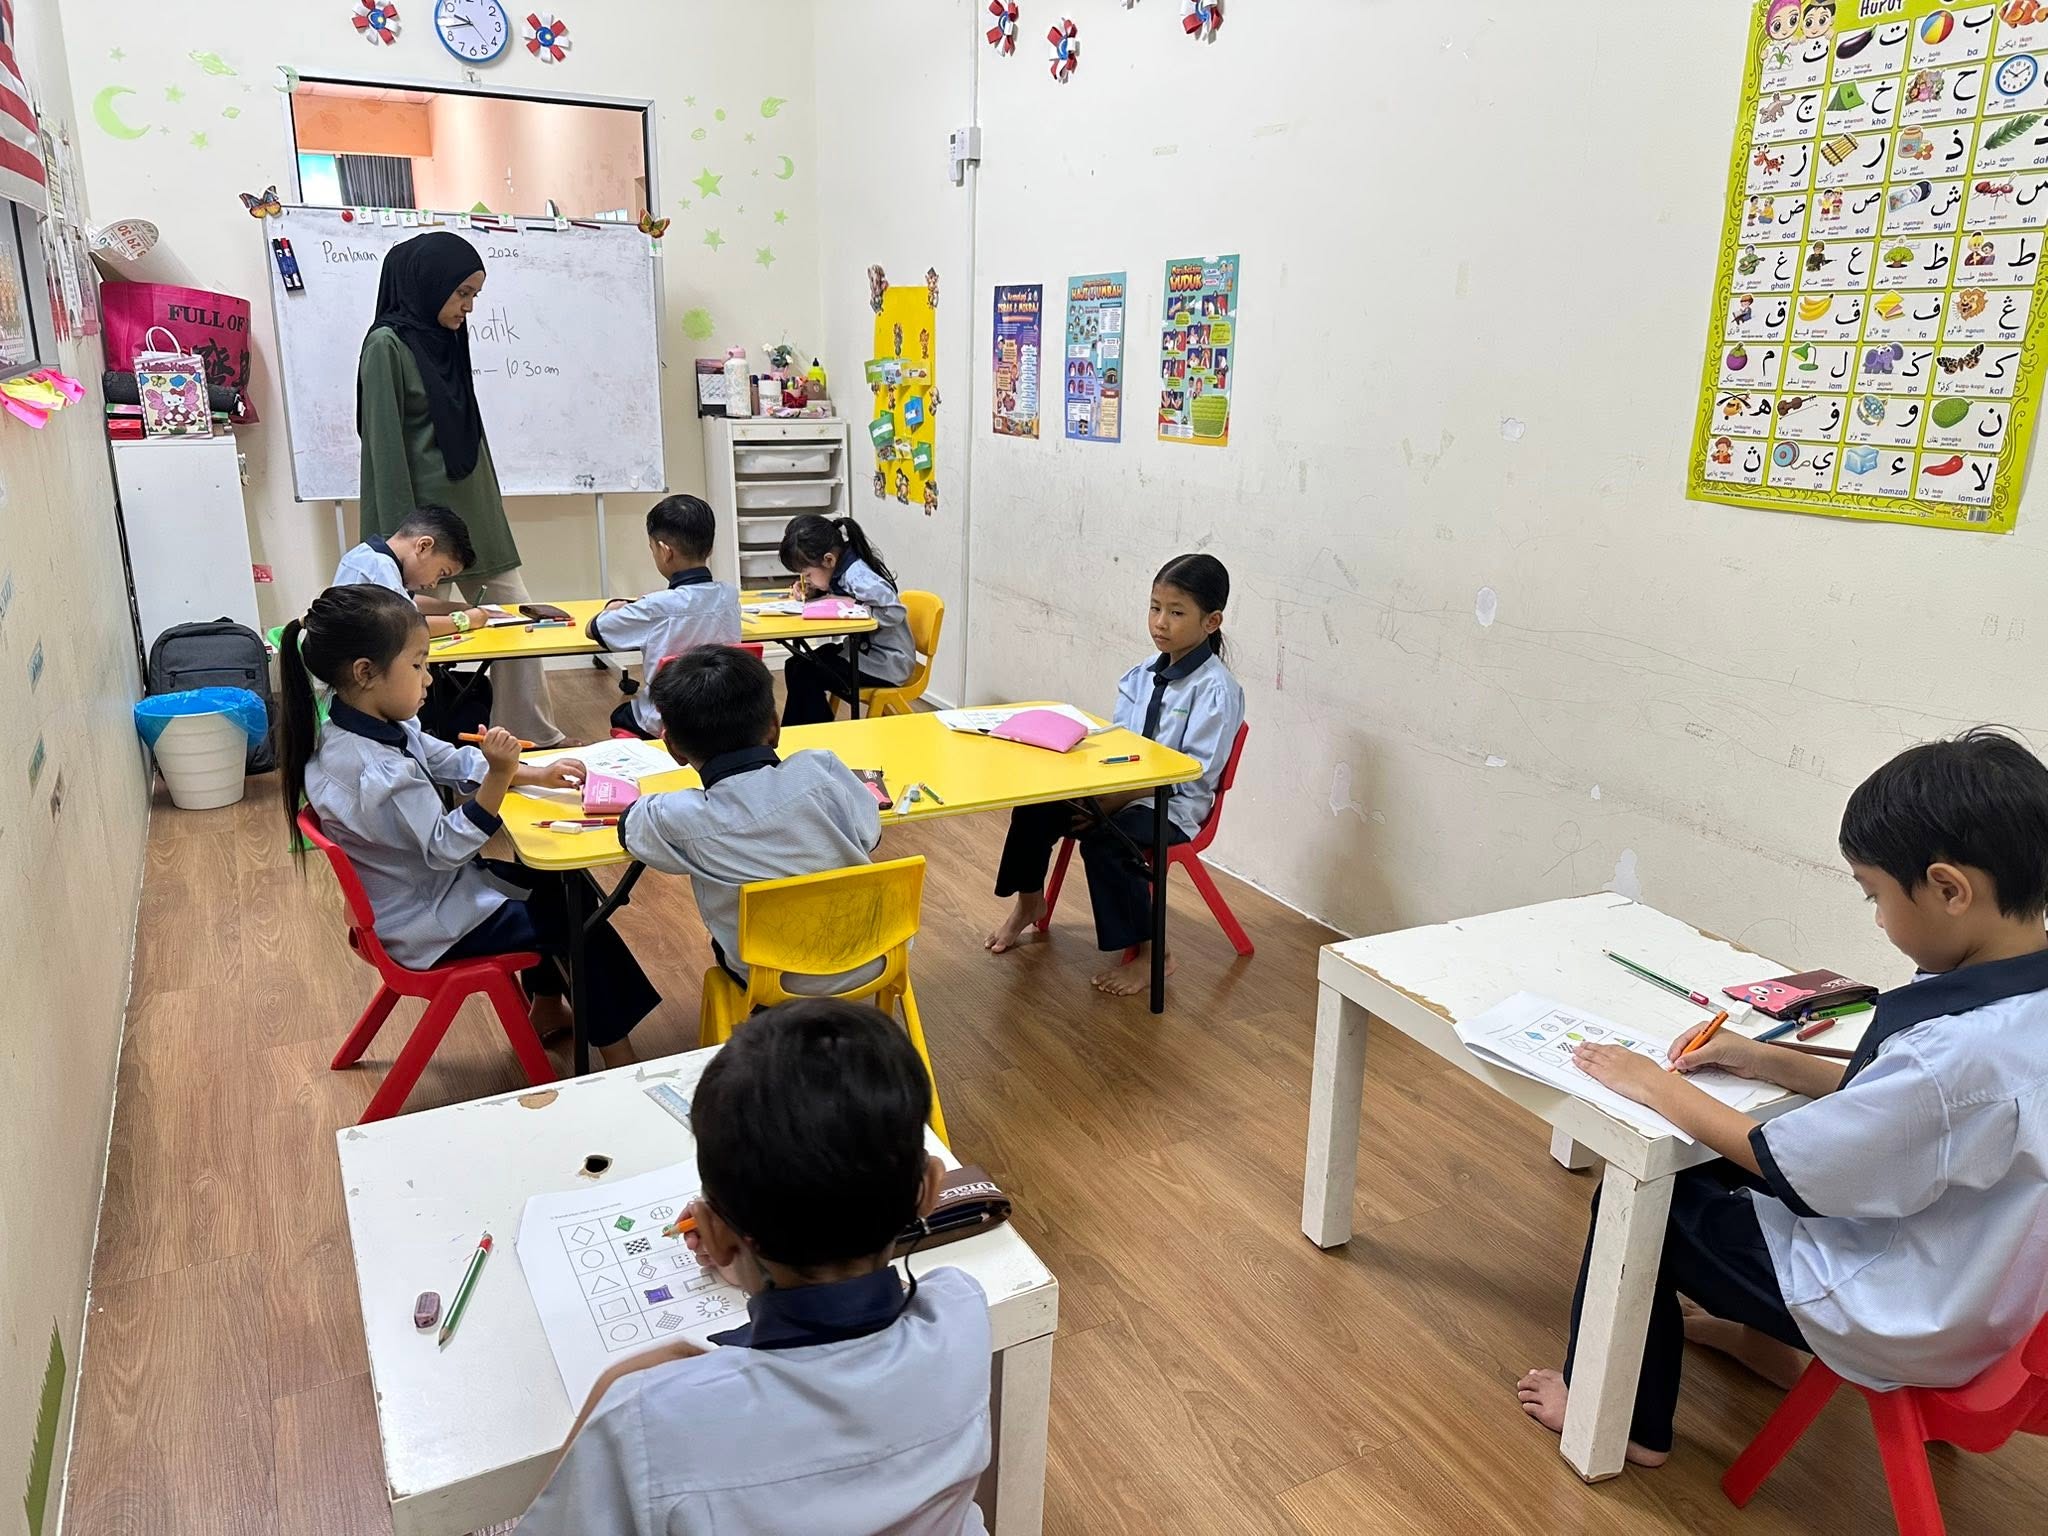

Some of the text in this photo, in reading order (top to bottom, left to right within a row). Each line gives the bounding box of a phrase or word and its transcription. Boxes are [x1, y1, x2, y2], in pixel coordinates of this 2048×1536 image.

[488, 5, 497, 17] 2
[494, 21, 502, 33] 3
[447, 30, 455, 41] 8
[459, 41, 466, 52] 7
[491, 36, 498, 47] 4
[469, 46, 477, 57] 6
[481, 44, 489, 55] 5
[322, 240, 379, 263] Penilaian
[488, 247, 519, 258] 2026
[1169, 274, 1203, 292] WUDUK
[168, 304, 245, 332] FULL OF
